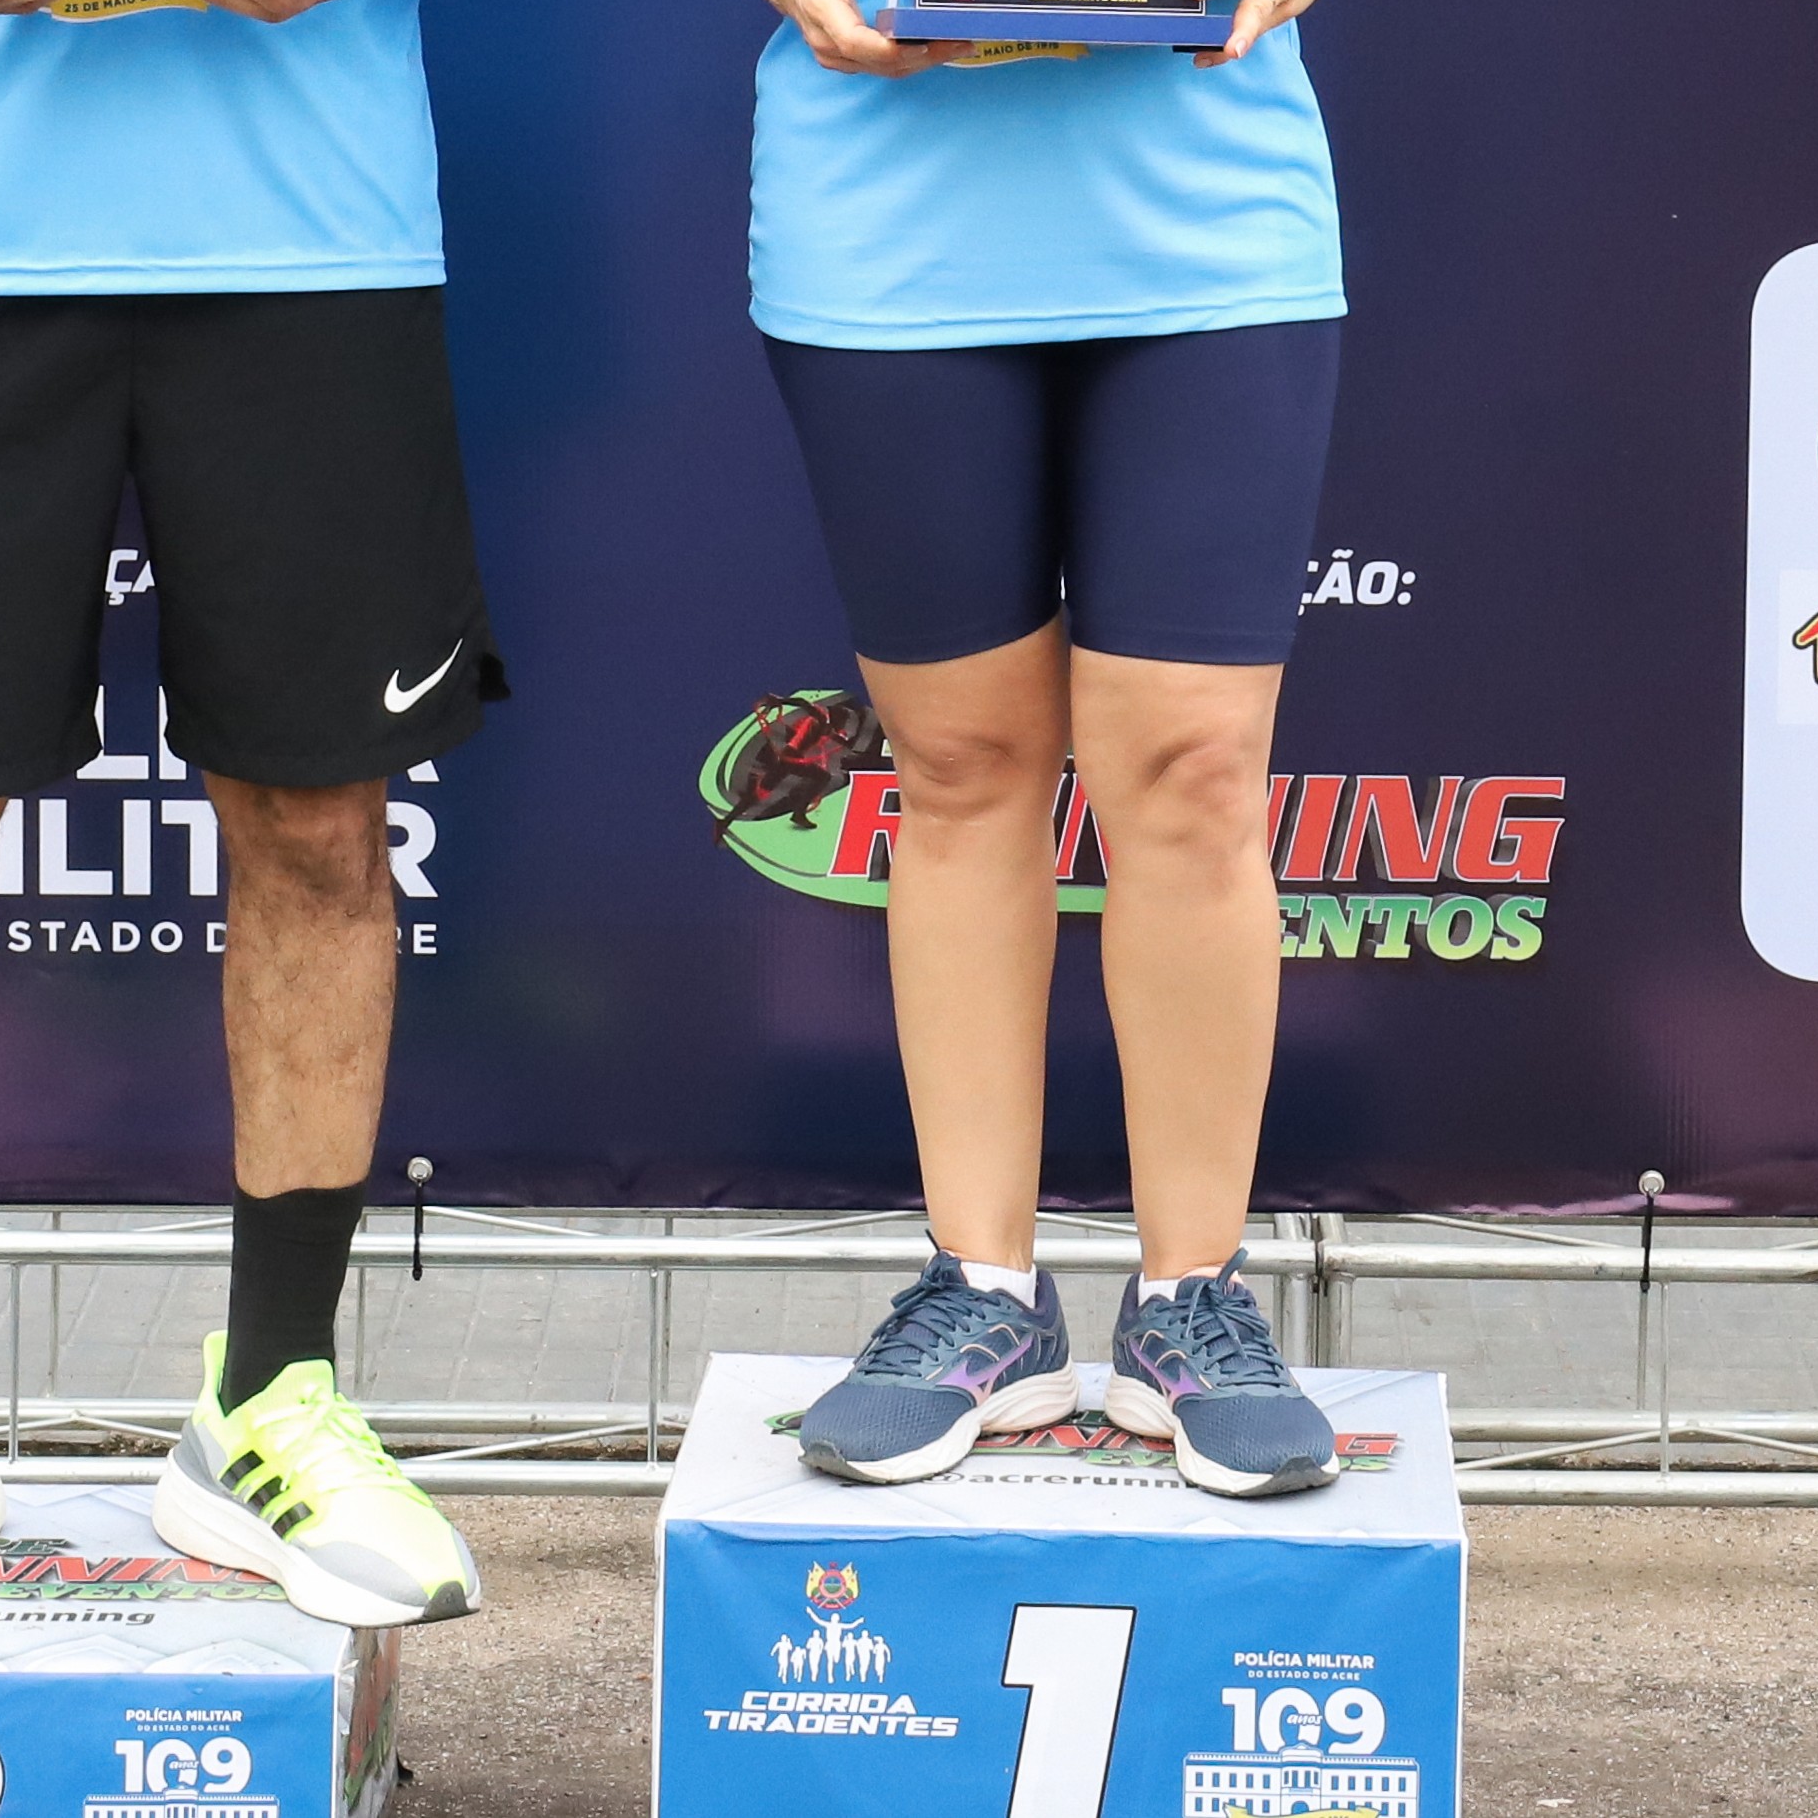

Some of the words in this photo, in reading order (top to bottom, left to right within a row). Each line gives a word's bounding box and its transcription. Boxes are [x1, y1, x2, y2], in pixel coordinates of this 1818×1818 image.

[64, 2, 79, 13] 25
[83, 0, 100, 12] DE
[984, 44, 1015, 58] MAIO
[1233, 1649, 1304, 1668] POLÍCIA
[1306, 1653, 1376, 1670] MILITAR
[1247, 1670, 1265, 1679] DO
[1266, 1670, 1311, 1680] ESTADO
[1312, 1671, 1329, 1680] DO
[1331, 1672, 1362, 1681] ACRE
[741, 1689, 917, 1715] CORRIDA
[1000, 1602, 1138, 1818] 1
[125, 1708, 183, 1722] POLÍCIA
[185, 1709, 243, 1722] MILITAR
[702, 1708, 960, 1738] TIRADENTES
[1220, 1686, 1387, 1756] 109
[1285, 1712, 1324, 1727] anos
[137, 1724, 151, 1732] DO
[152, 1724, 189, 1732] ESTADO
[206, 1724, 231, 1732] ACRE
[114, 1736, 253, 1794] 109
